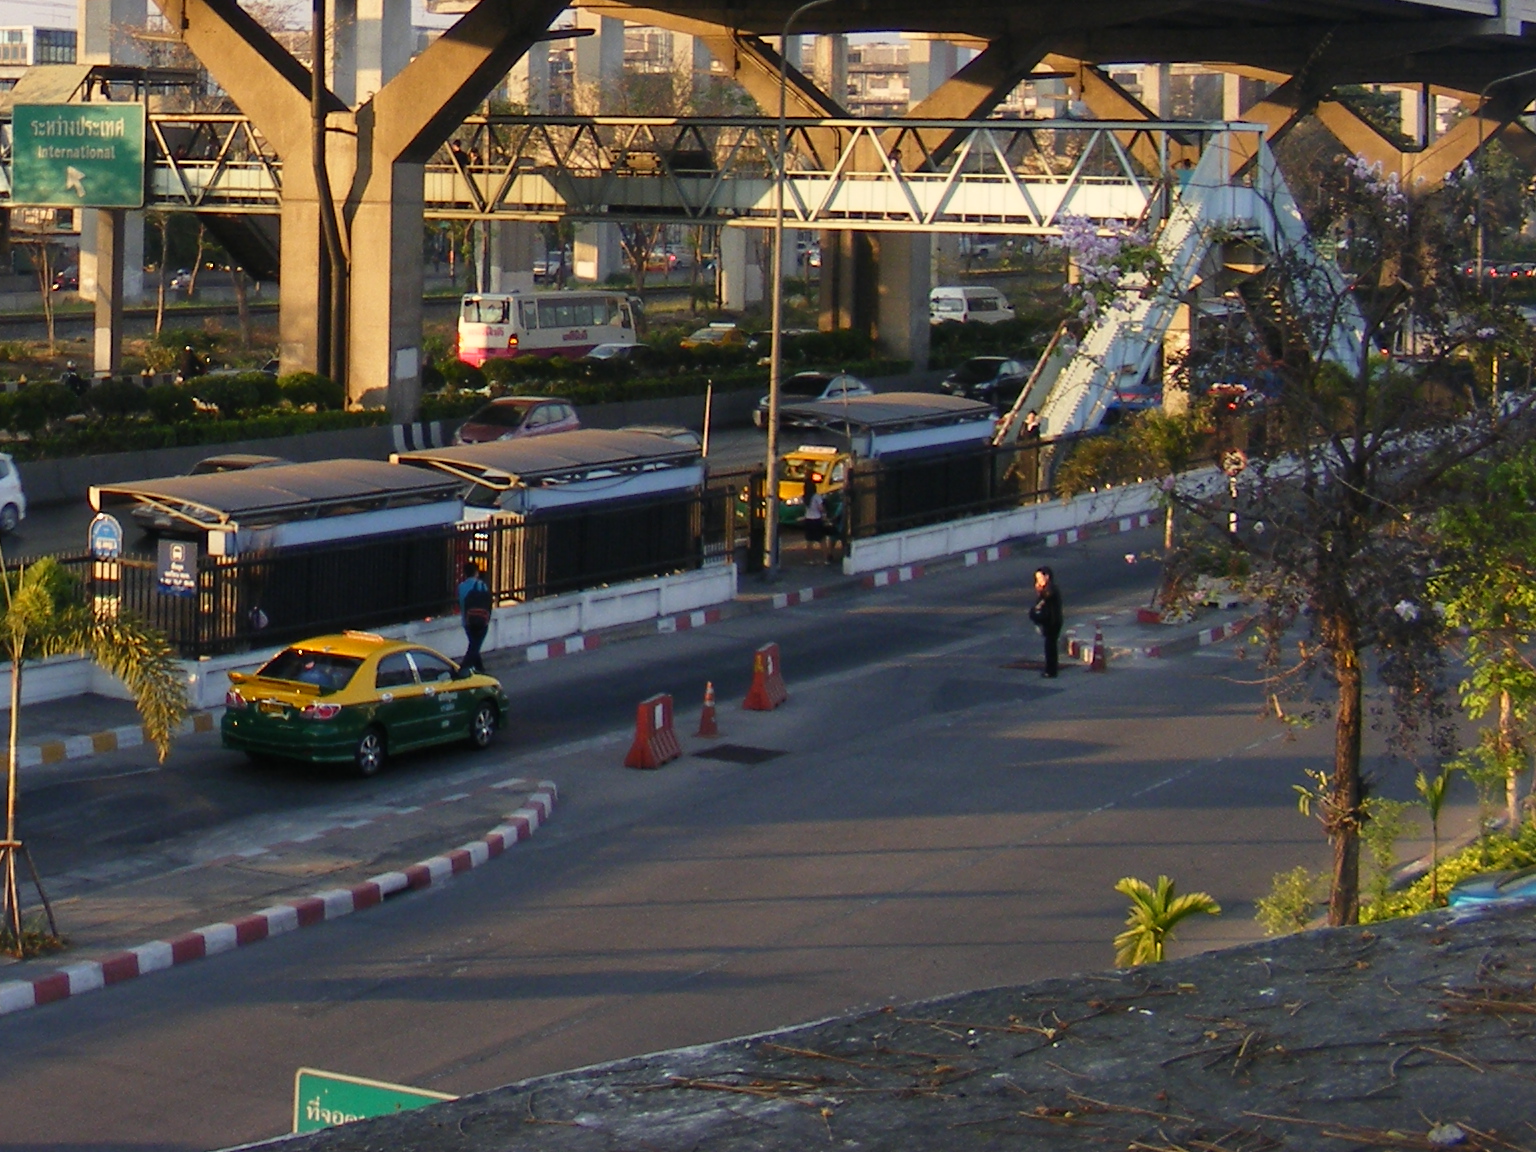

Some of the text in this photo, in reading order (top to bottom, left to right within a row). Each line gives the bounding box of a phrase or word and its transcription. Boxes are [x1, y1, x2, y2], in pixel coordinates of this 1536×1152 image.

[30, 115, 125, 137] ระหว่างประเทศ
[37, 145, 116, 160] International
